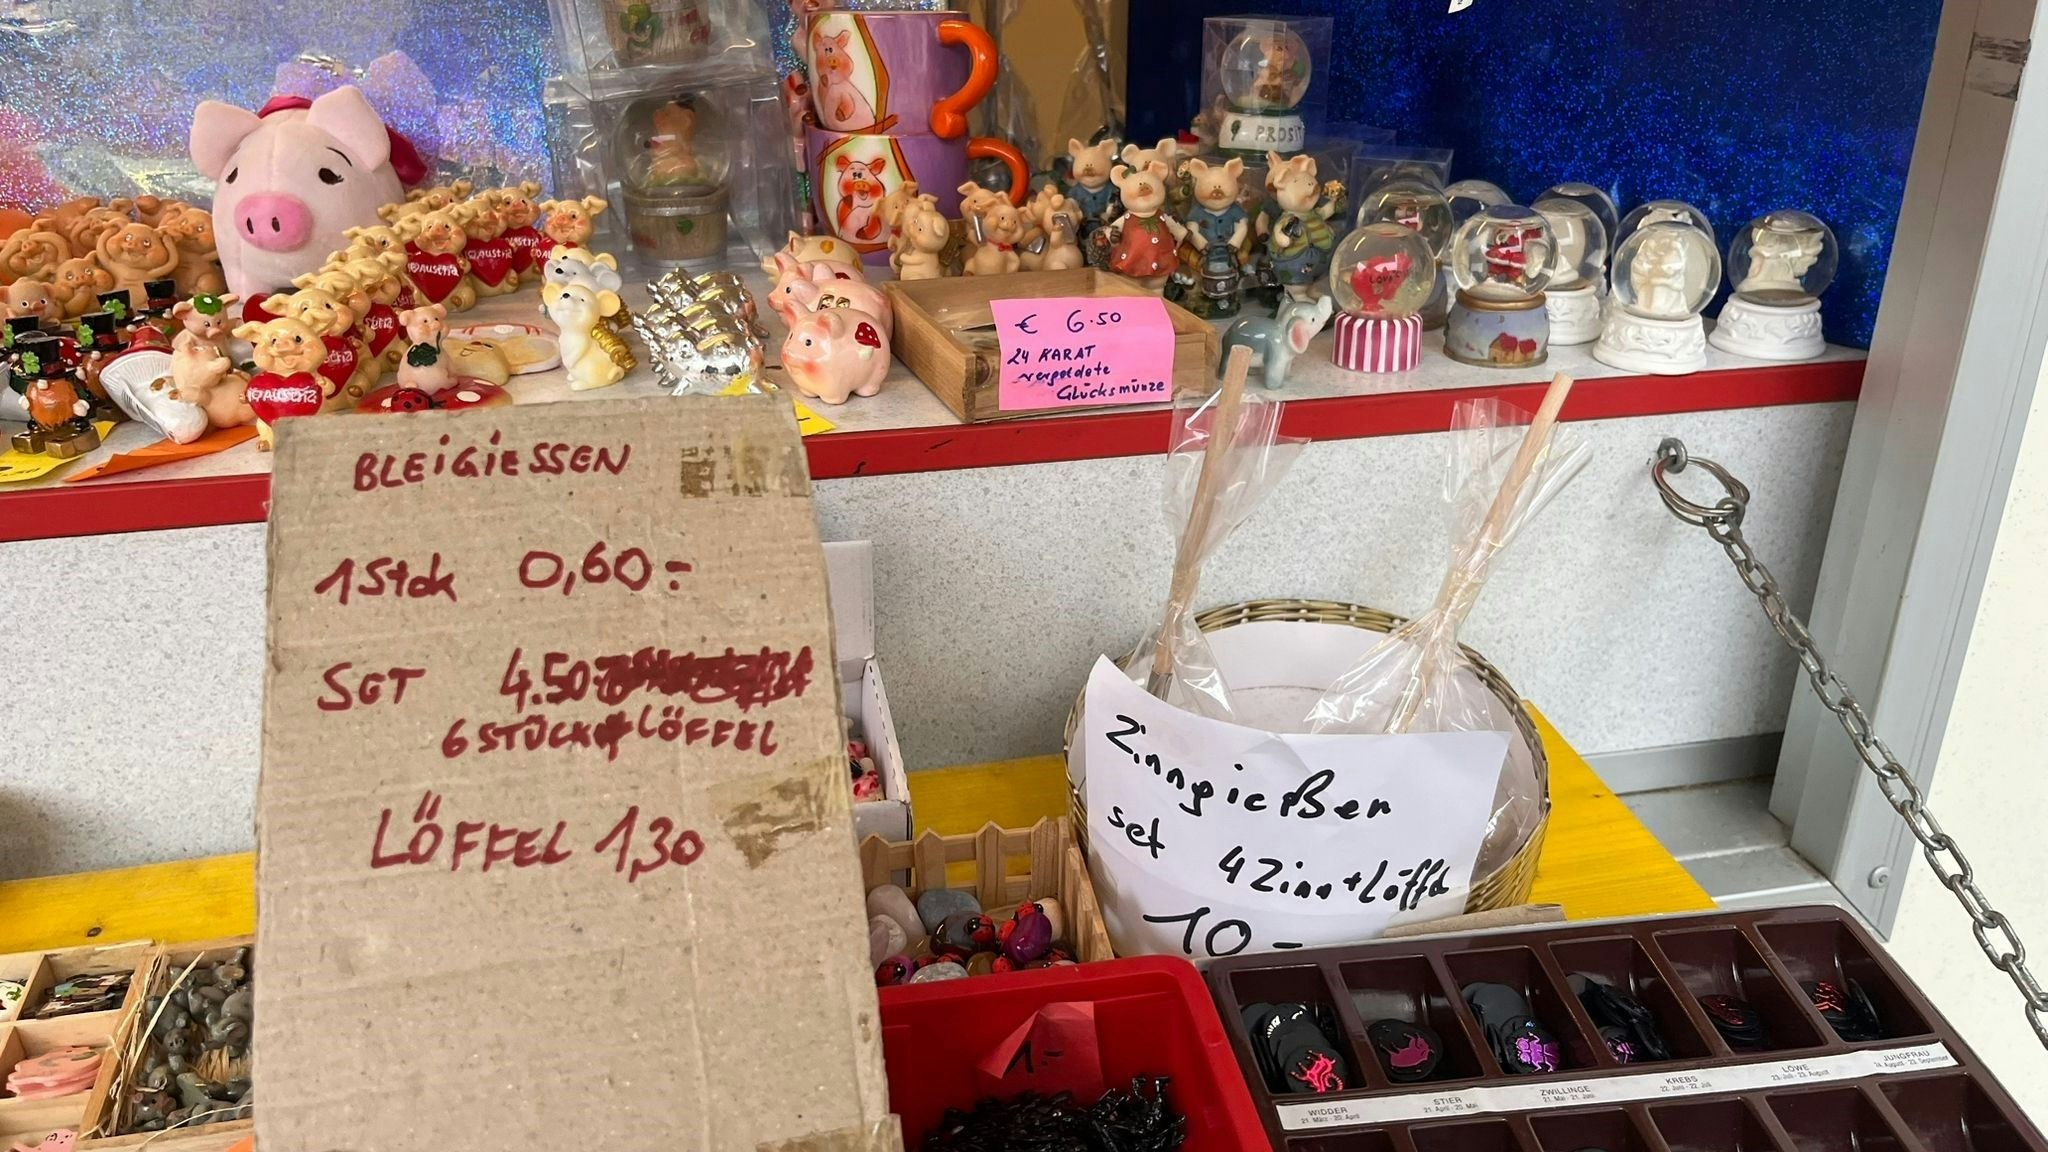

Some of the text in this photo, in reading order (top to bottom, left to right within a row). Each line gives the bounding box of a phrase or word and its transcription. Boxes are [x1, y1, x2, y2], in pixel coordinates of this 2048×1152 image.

[1255, 125, 1303, 142] PROSIT
[1015, 309, 1122, 334] € 6.50
[1007, 345, 1096, 365] 24 KARAT
[371, 789, 705, 883] LÖFFEL 1,30
[1107, 806, 1165, 859] set
[1884, 1050, 1930, 1062] JUNGFRAU
[1665, 1075, 1698, 1085] KREBS
[1540, 1085, 1591, 1096] ZWILLINGE
[1433, 1096, 1463, 1105] STIER
[1308, 1106, 1348, 1117] WIDDER
